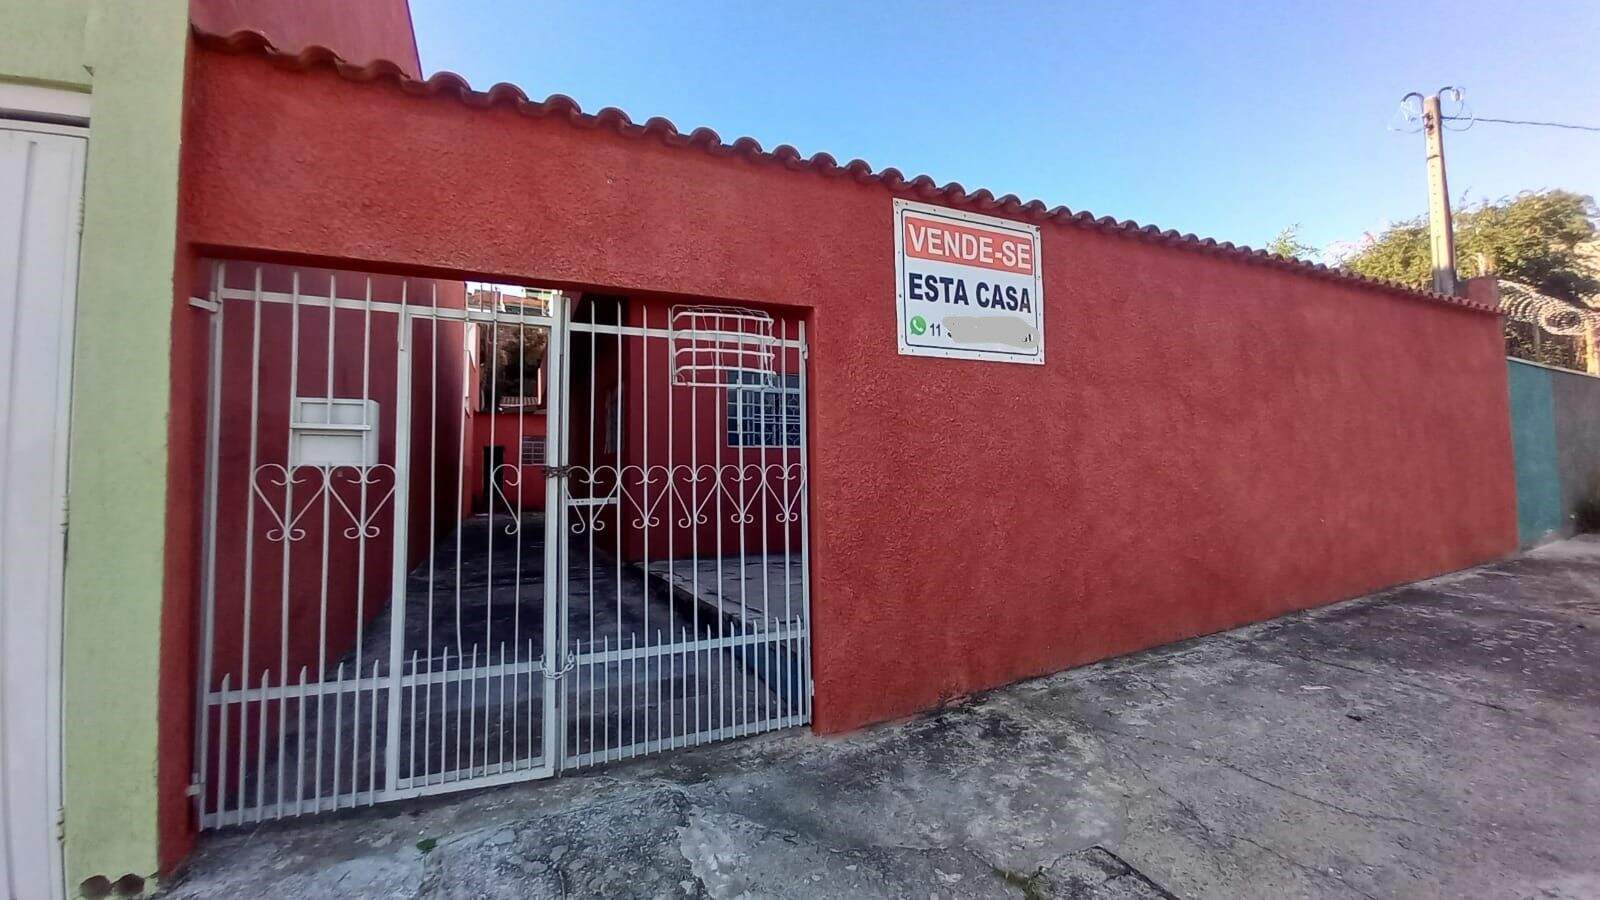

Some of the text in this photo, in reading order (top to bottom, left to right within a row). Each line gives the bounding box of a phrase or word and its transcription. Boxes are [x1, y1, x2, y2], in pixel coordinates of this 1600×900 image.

[908, 223, 1031, 270] VENDE-SE
[909, 273, 1031, 313] ESTA CASA
[929, 323, 941, 336] 11
